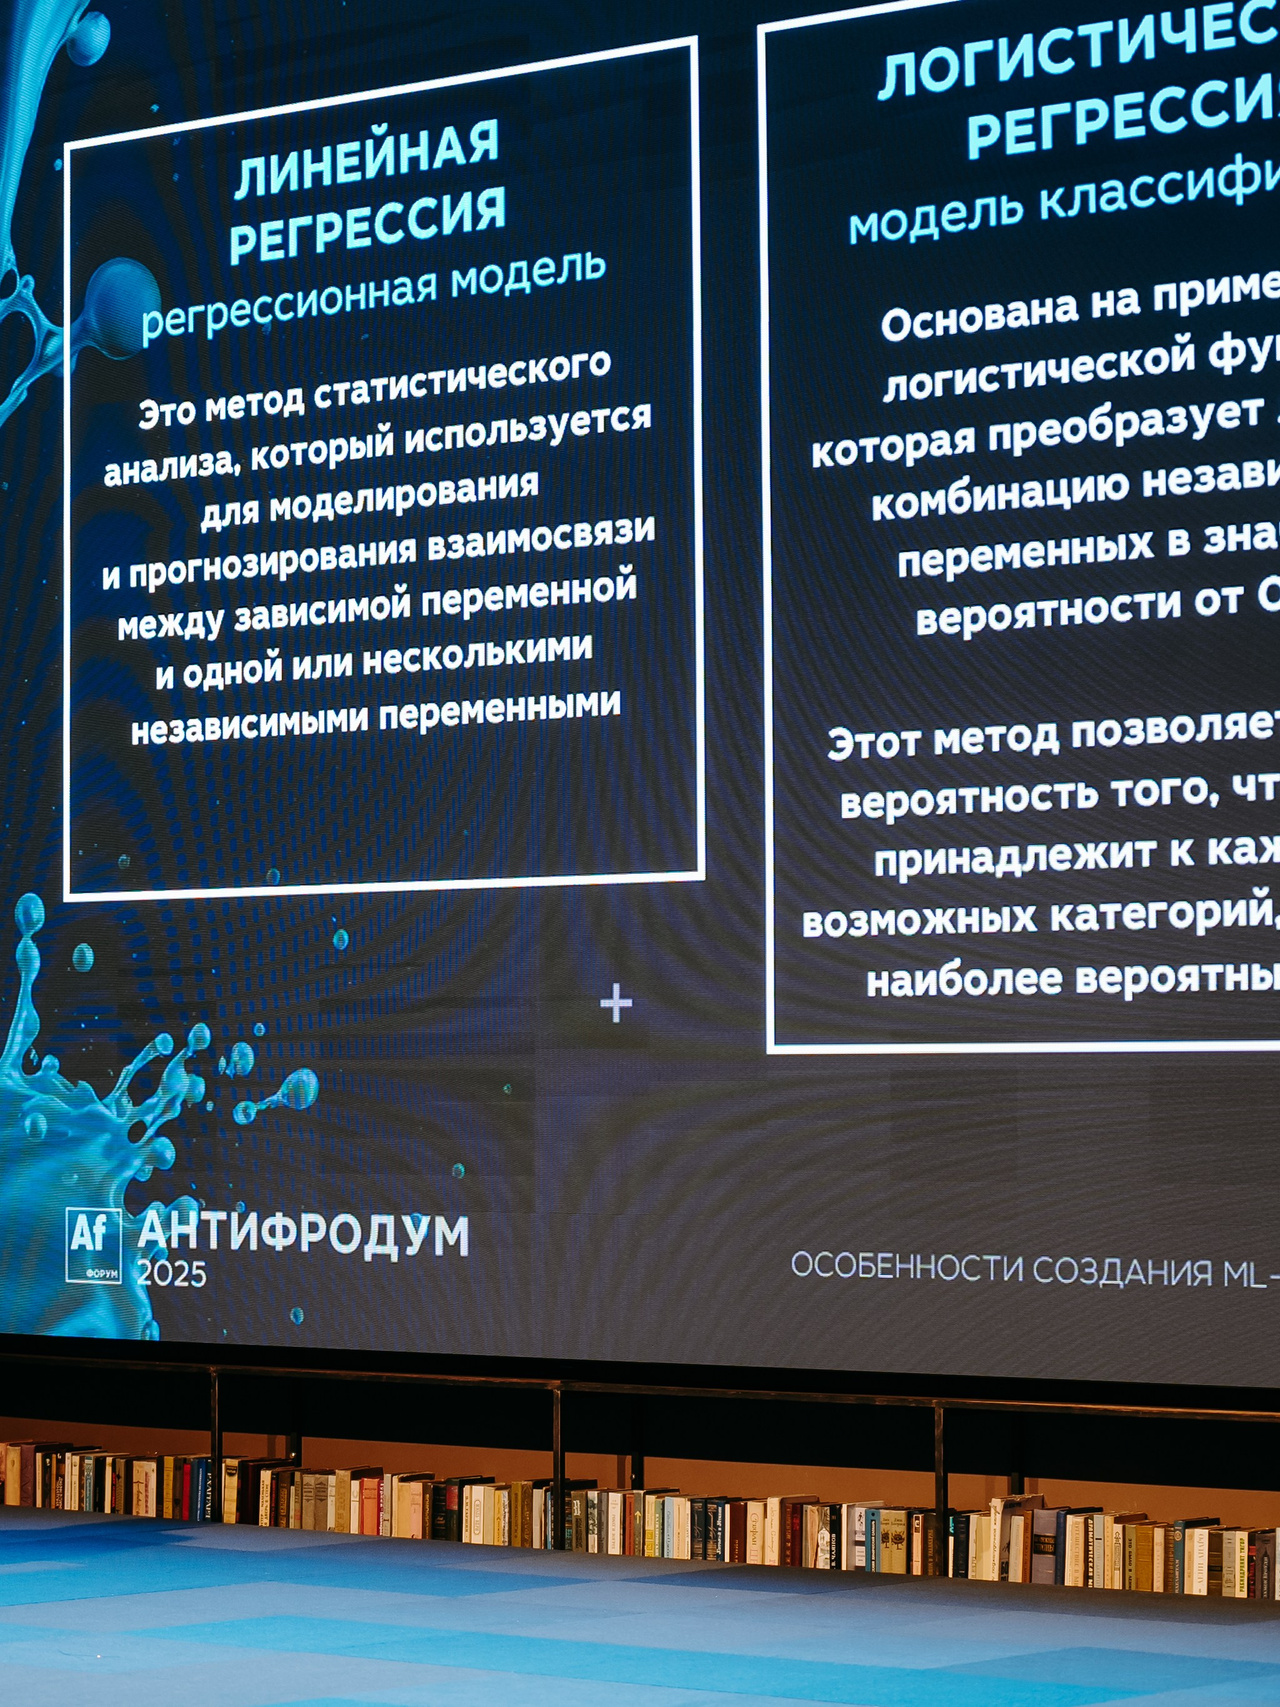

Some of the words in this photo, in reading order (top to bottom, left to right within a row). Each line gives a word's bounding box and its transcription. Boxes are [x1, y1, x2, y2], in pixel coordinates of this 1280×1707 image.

[876, 0, 1279, 102] ЛОГИСТИЧЕС
[967, 72, 1280, 161] РЕГРЕССИ
[233, 118, 499, 201] ЛИНЕЙНАЯ
[230, 186, 506, 267] РЕГРЕССИЯ
[849, 194, 1025, 245] модель
[140, 269, 438, 348] регрессионная
[450, 250, 608, 300] модель
[881, 294, 1080, 343] Основана
[1091, 287, 1142, 319] на
[1153, 270, 1280, 317] приме
[138, 398, 197, 430] Это
[205, 387, 305, 422] метод
[313, 350, 612, 410] статистического
[882, 331, 1196, 404] логистической
[1208, 330, 1280, 376] фу
[103, 450, 241, 488] анализа,
[251, 421, 394, 471] который
[404, 403, 652, 454] используется
[812, 426, 976, 469] которая
[988, 397, 1265, 457] преобразует
[200, 500, 260, 535] для
[270, 471, 539, 523] моделирования
[872, 472, 1130, 522] комбинацию
[102, 566, 121, 591] и
[129, 538, 417, 594] прогнозирования
[427, 515, 655, 561] взаимосвязи
[898, 531, 1155, 583] переменных
[1167, 528, 1191, 557] в
[1203, 521, 1280, 555] зна
[118, 609, 226, 642] между
[233, 582, 411, 632] зависимой
[420, 564, 638, 614] переменной
[916, 590, 1182, 641] вероятности
[1194, 586, 1245, 617] от
[156, 666, 174, 690] и
[183, 647, 283, 692] одной
[292, 652, 353, 680] или
[362, 634, 593, 675] несколькими
[131, 707, 369, 746] независимыми
[379, 690, 621, 736] переменными
[827, 726, 923, 762] Этот
[933, 722, 1061, 757] метод
[1071, 710, 1280, 748] позволяе
[841, 781, 1099, 826] вероятность
[1110, 776, 1220, 809] того,
[1232, 772, 1280, 802] чт
[874, 840, 1158, 885] принадлежит
[1170, 838, 1195, 867] к
[802, 905, 1039, 938] возможных
[867, 957, 1064, 997] наиболее
[70, 1213, 107, 1251] Af
[137, 1209, 469, 1263] АНТИФРОДУМ
[86, 1268, 118, 1279] ФОРУМ
[137, 1259, 207, 1288] 2025
[791, 1250, 1024, 1282] ОСОБЕННОСТИ
[1033, 1255, 1213, 1289] СОЗДАНИЯ
